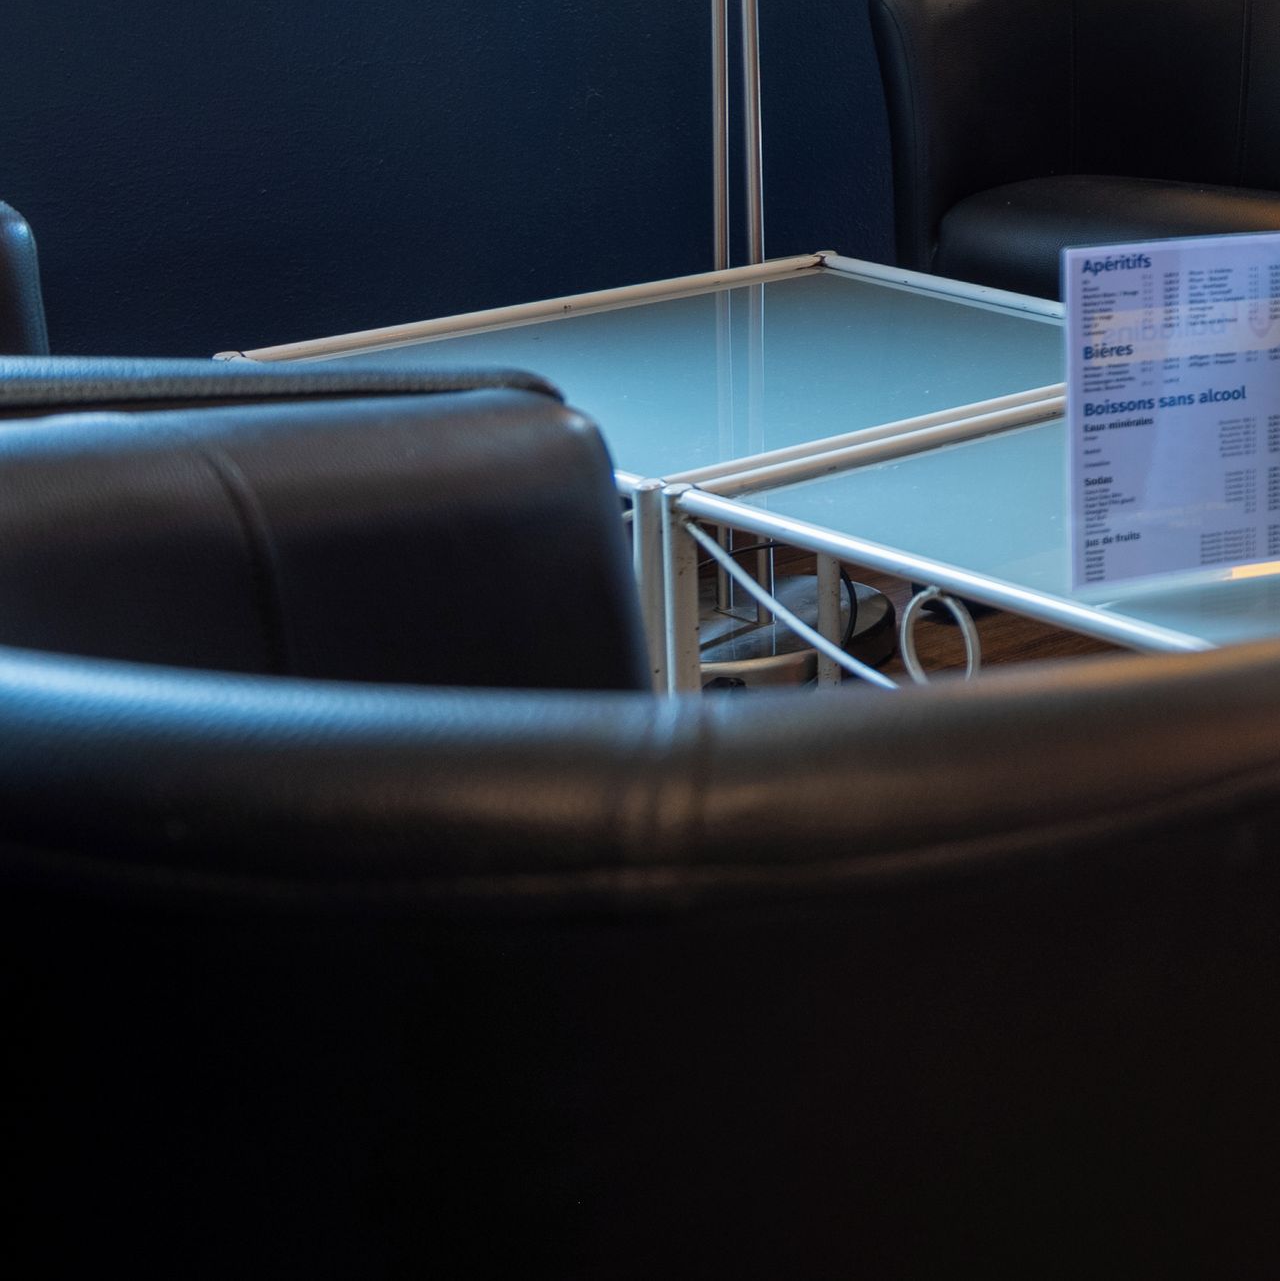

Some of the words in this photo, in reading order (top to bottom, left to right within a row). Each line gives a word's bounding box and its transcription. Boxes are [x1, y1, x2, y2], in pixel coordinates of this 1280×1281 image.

[1082, 254, 1152, 275] Apéritifs
[1083, 342, 1134, 360] Bières
[1083, 398, 1155, 417] Boissons
[1159, 391, 1195, 409] sans
[1198, 385, 1247, 404] alcool
